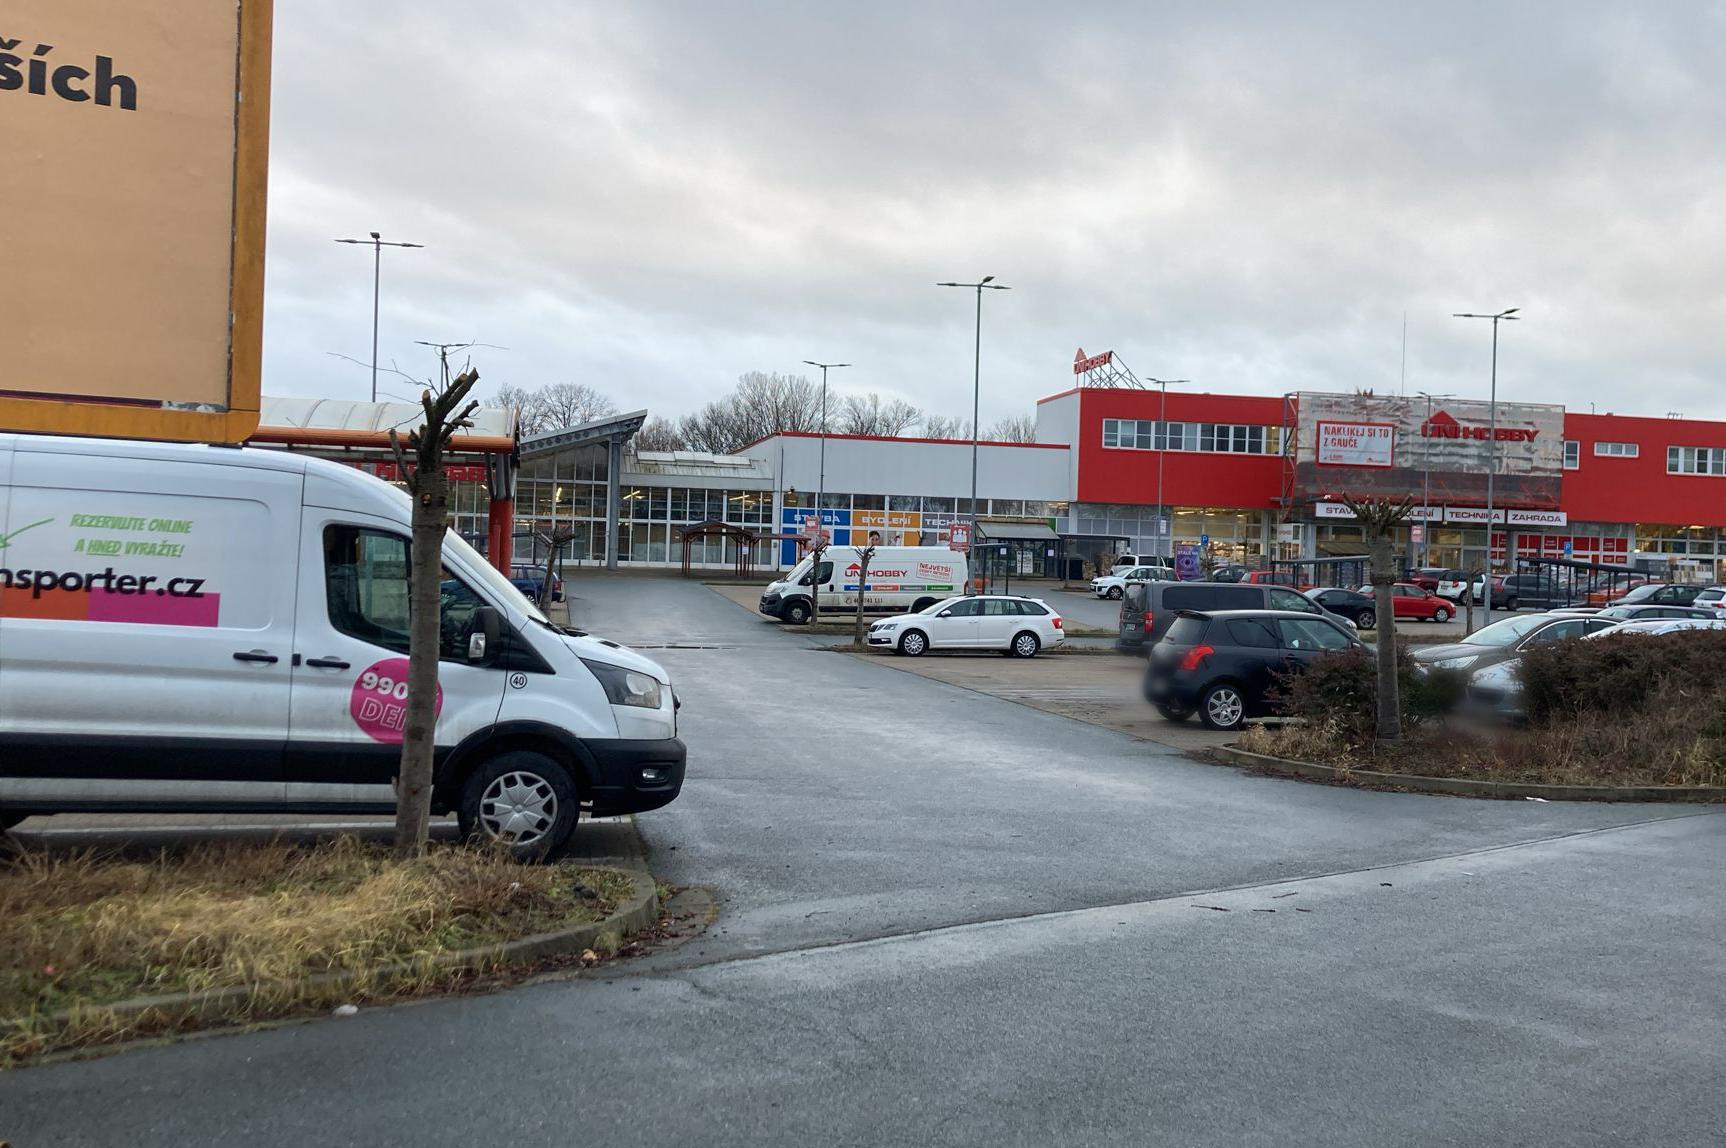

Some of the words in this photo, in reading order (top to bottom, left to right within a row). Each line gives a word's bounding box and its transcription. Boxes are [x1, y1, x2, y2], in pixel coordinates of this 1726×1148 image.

[70, 513, 147, 531] REZERVUJTE
[148, 518, 193, 534] ONLINE
[1512, 513, 1562, 523] ZAHRADA
[73, 538, 85, 552] A
[87, 539, 121, 555] HNED
[125, 539, 185, 558] VYRAŽTE!
[512, 675, 525, 686] 40
